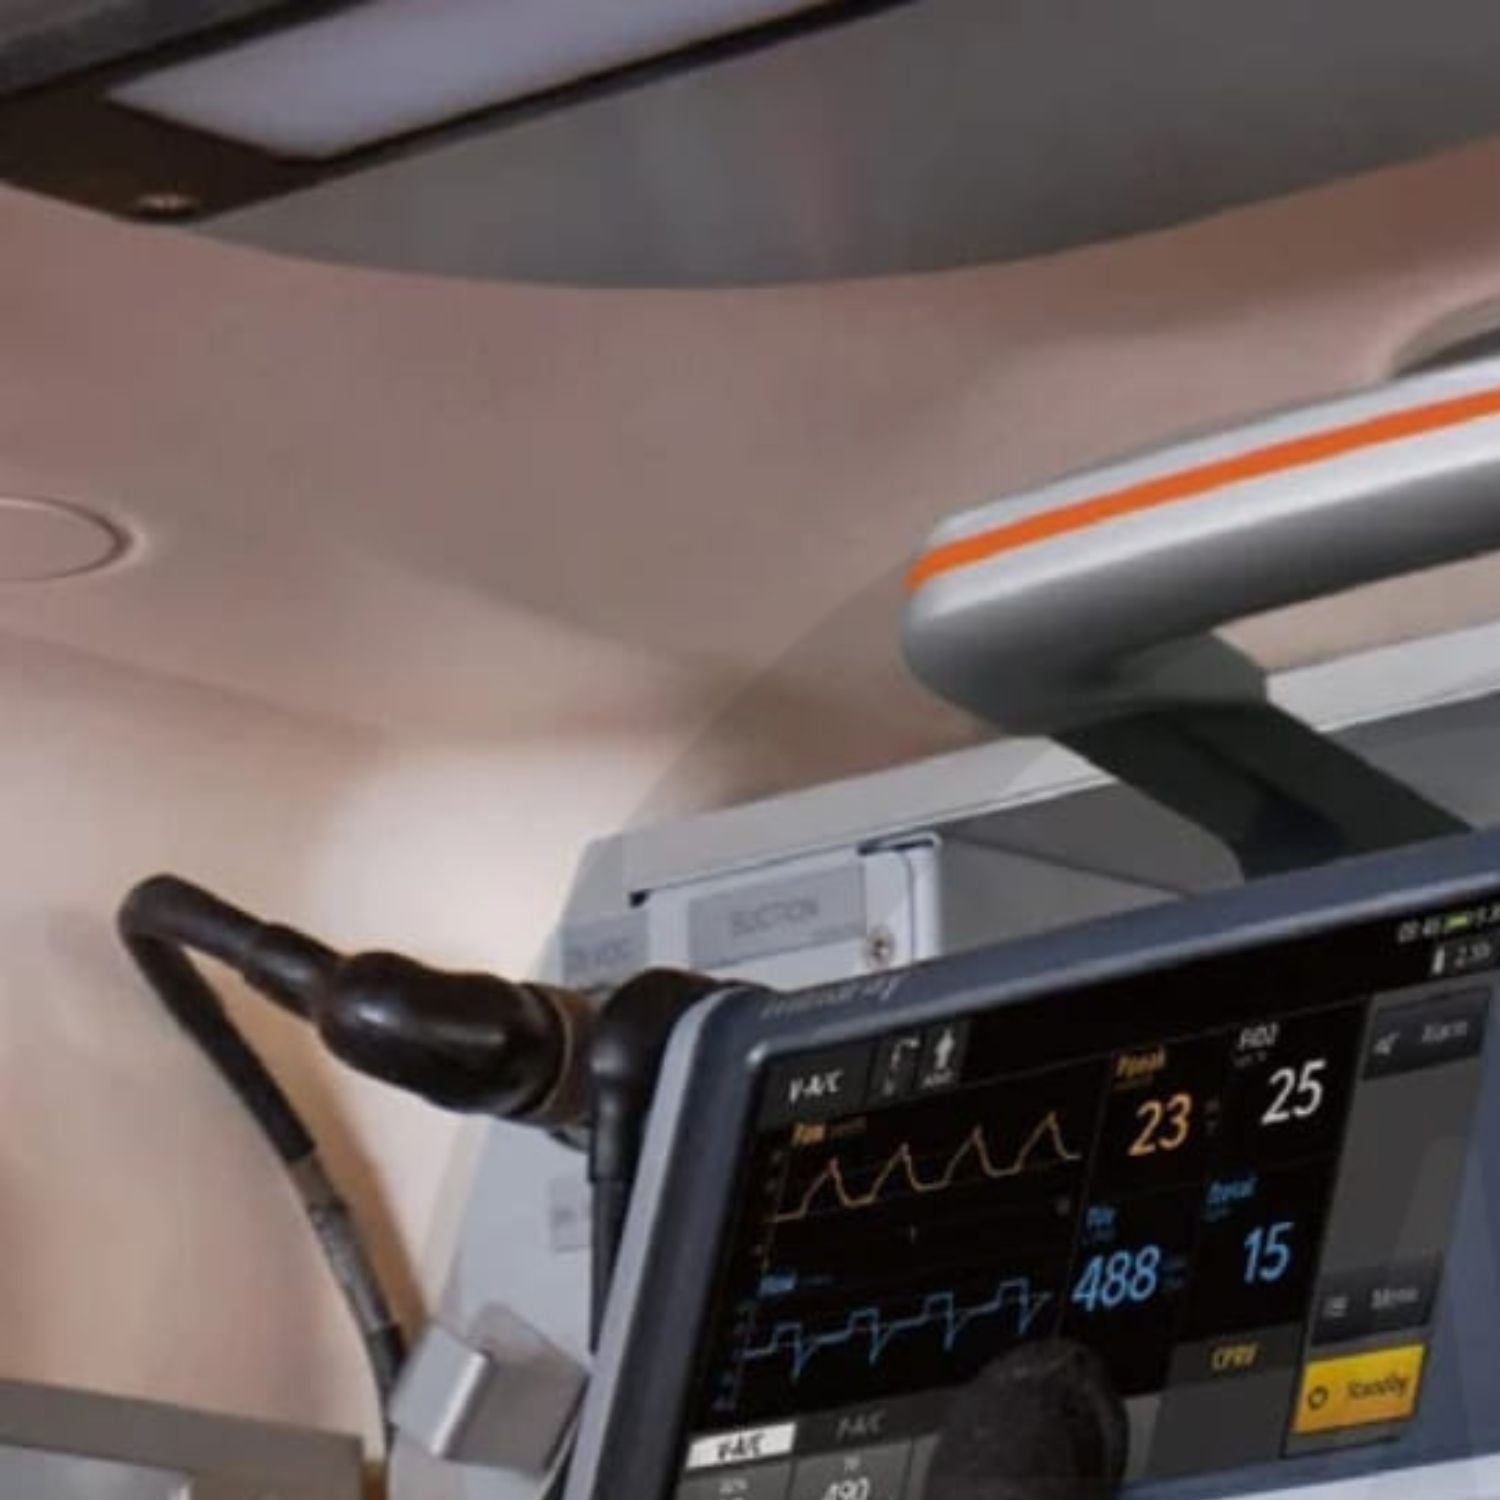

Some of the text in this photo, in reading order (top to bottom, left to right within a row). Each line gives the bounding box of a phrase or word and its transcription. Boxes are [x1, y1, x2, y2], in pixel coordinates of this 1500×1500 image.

[1127, 1092, 1193, 1157] 23
[1261, 1058, 1328, 1126] 25
[1071, 1243, 1162, 1314] 488
[1243, 1220, 1295, 1285] 15
